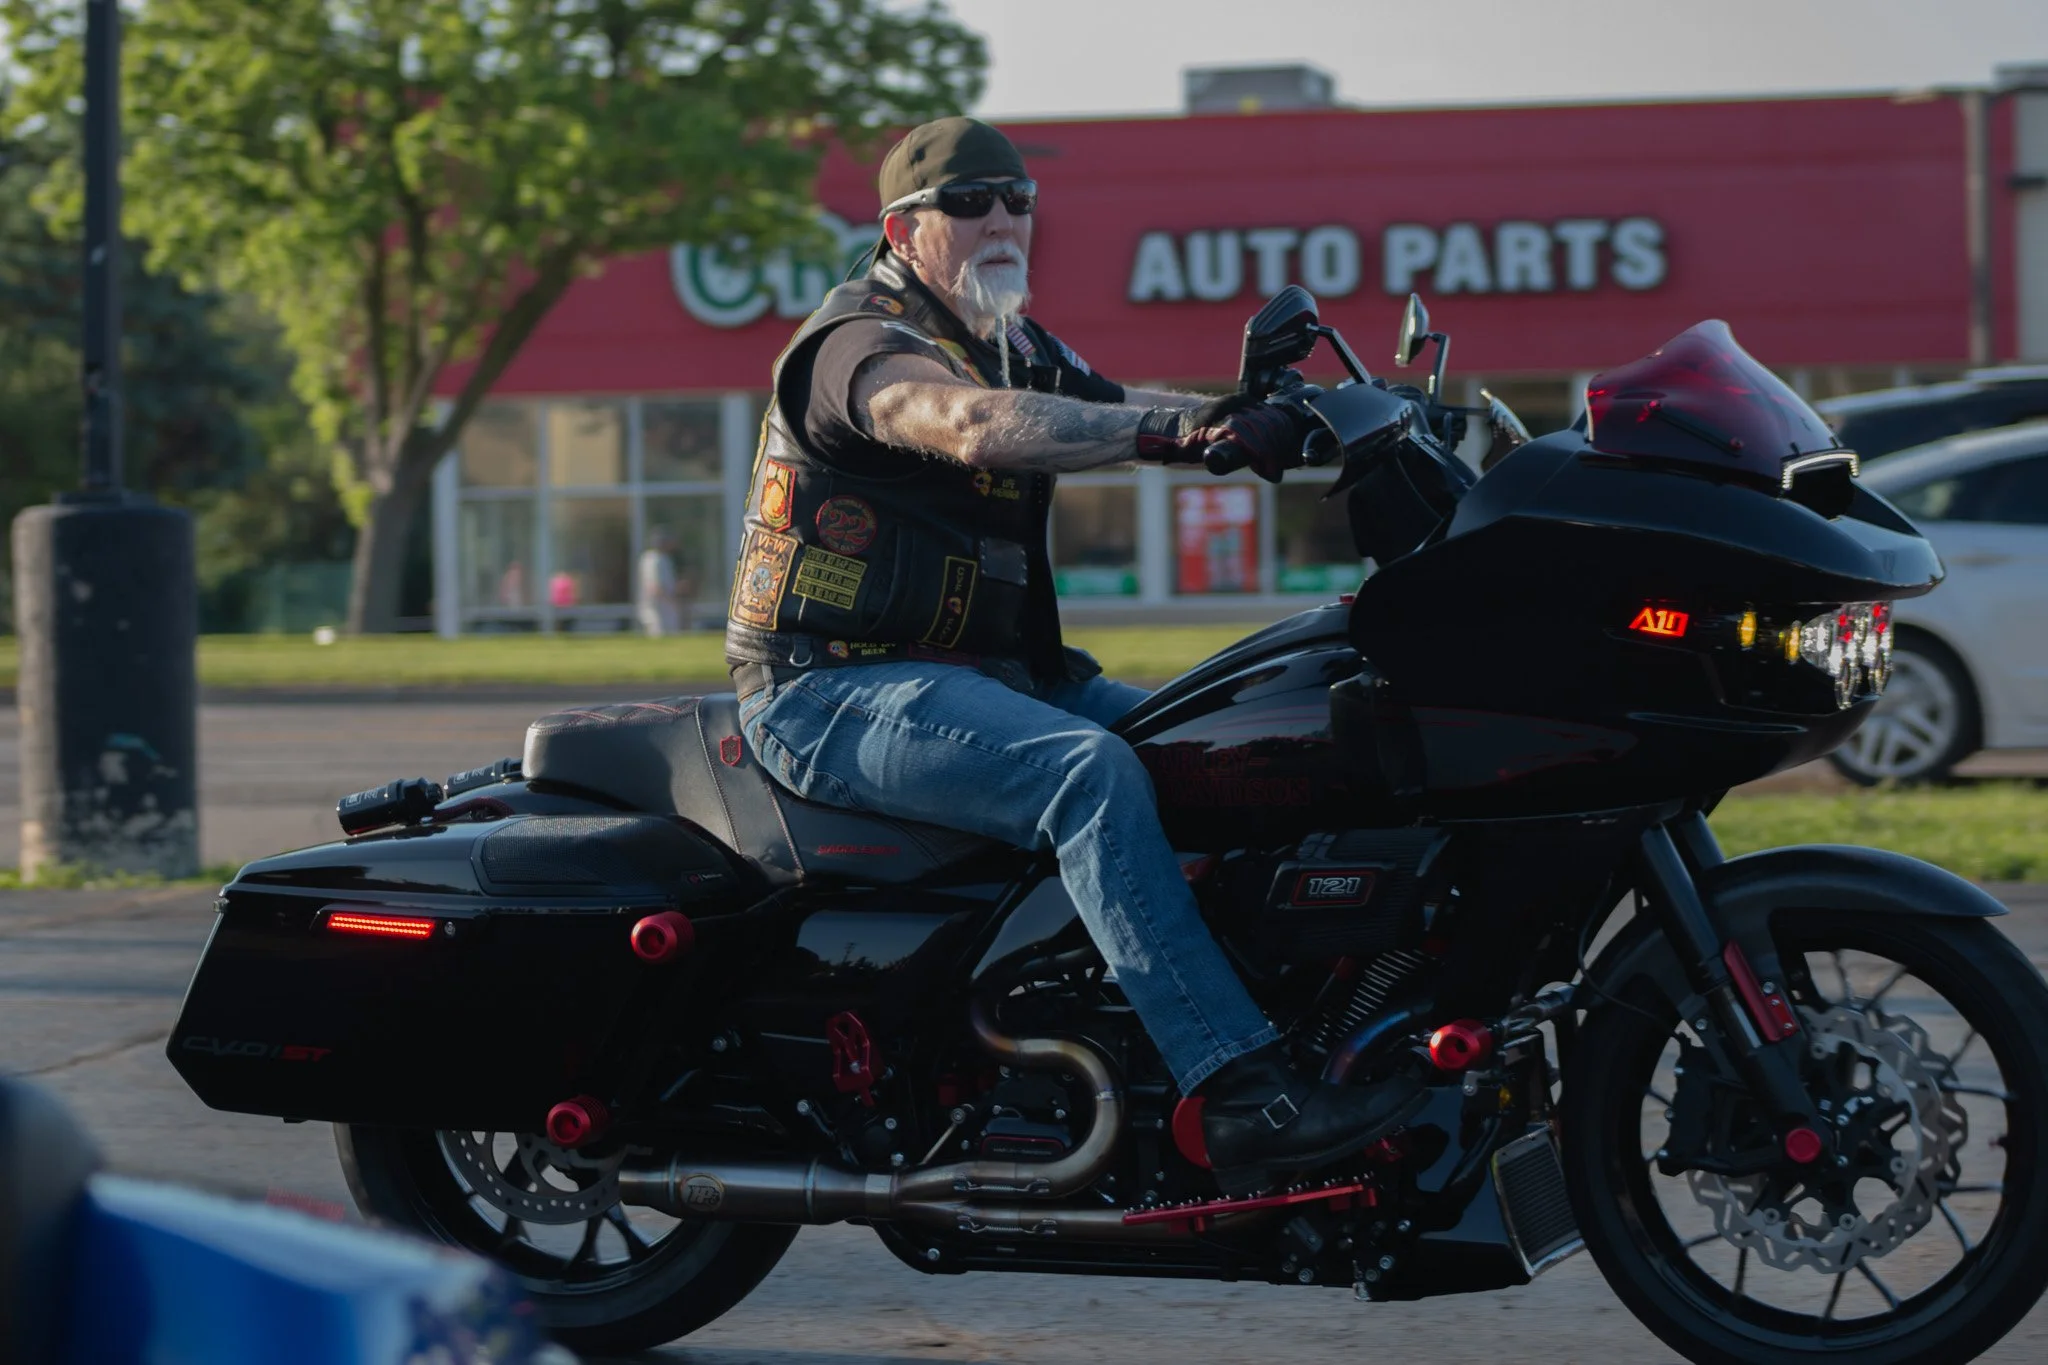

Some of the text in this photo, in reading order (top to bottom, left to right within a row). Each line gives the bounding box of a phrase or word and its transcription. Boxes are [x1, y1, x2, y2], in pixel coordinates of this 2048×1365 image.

[1130, 219, 1666, 301] AUTO PARTS
[826, 509, 866, 545] 22
[758, 533, 788, 553] VFW
[1308, 877, 1361, 895] 121
